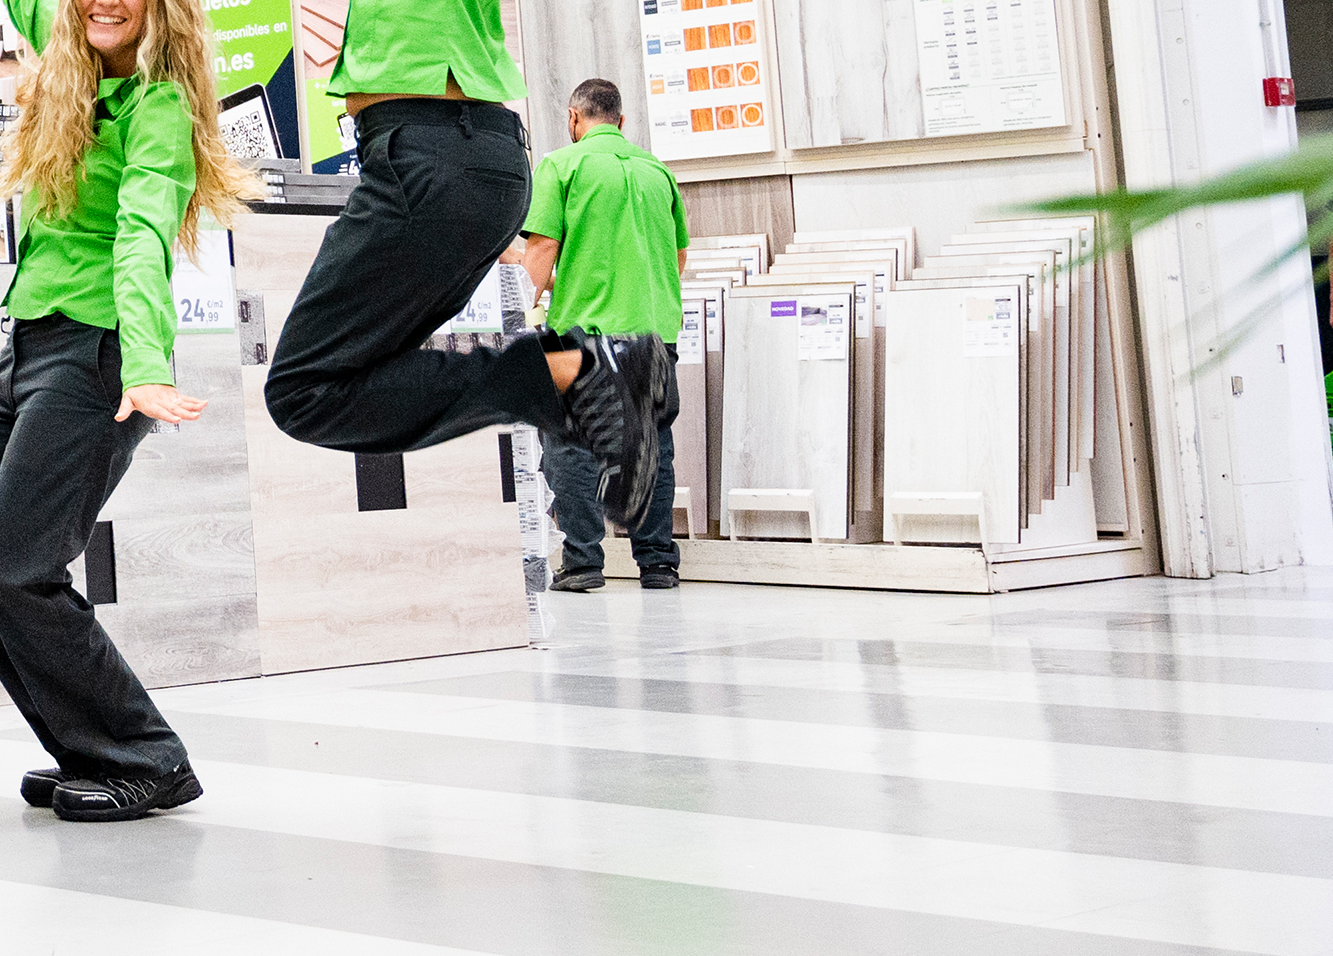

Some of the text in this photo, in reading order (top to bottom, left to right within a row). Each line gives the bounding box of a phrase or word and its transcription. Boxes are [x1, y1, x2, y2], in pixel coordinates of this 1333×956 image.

[213, 22, 287, 43] disponibles en
[180, 298, 205, 323] 24
